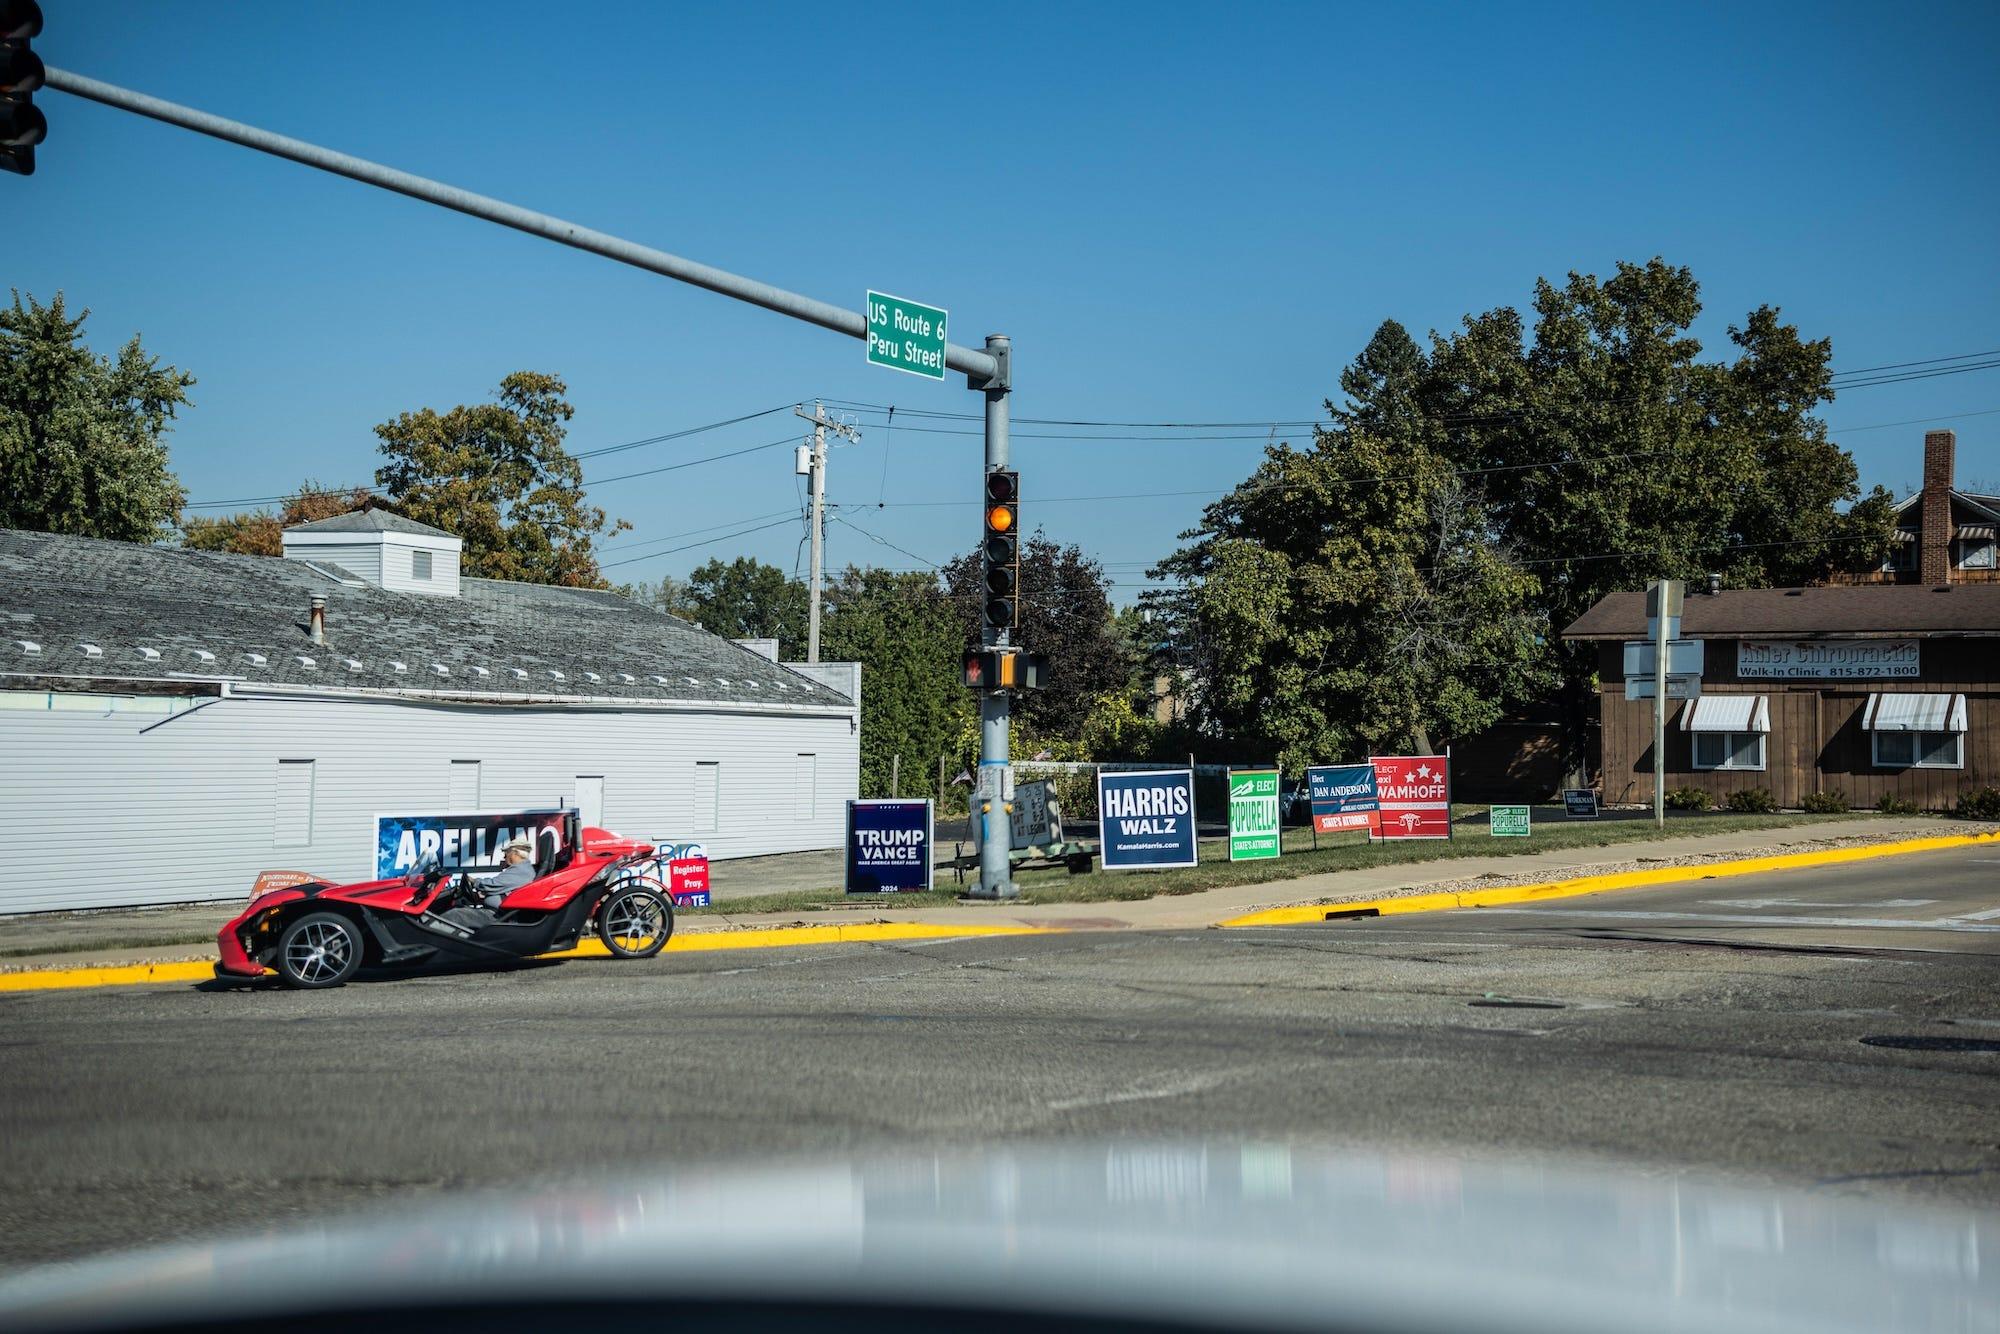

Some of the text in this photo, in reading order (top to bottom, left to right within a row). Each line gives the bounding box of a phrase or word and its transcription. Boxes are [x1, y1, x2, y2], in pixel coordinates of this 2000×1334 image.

[869, 301, 945, 341] US Route 6
[869, 331, 942, 369] Peru Street
[1740, 640, 1918, 664] Adler Chiropractic
[1740, 666, 1918, 677] Walk-In Clinic 815-872-1800
[1256, 780, 1275, 792] ELECT
[1311, 774, 1324, 783] Elect
[1314, 783, 1372, 798] DAN ANDERSON
[1105, 786, 1189, 818] HARRIS
[1230, 800, 1277, 833] POPURELLA
[1120, 818, 1177, 835] WALZ
[854, 830, 925, 846] TRUMP
[861, 847, 917, 859] VANCE
[1116, 842, 1180, 851] KamalaHarris.com
[673, 865, 706, 876] Register.
[684, 879, 704, 889] Pray.
